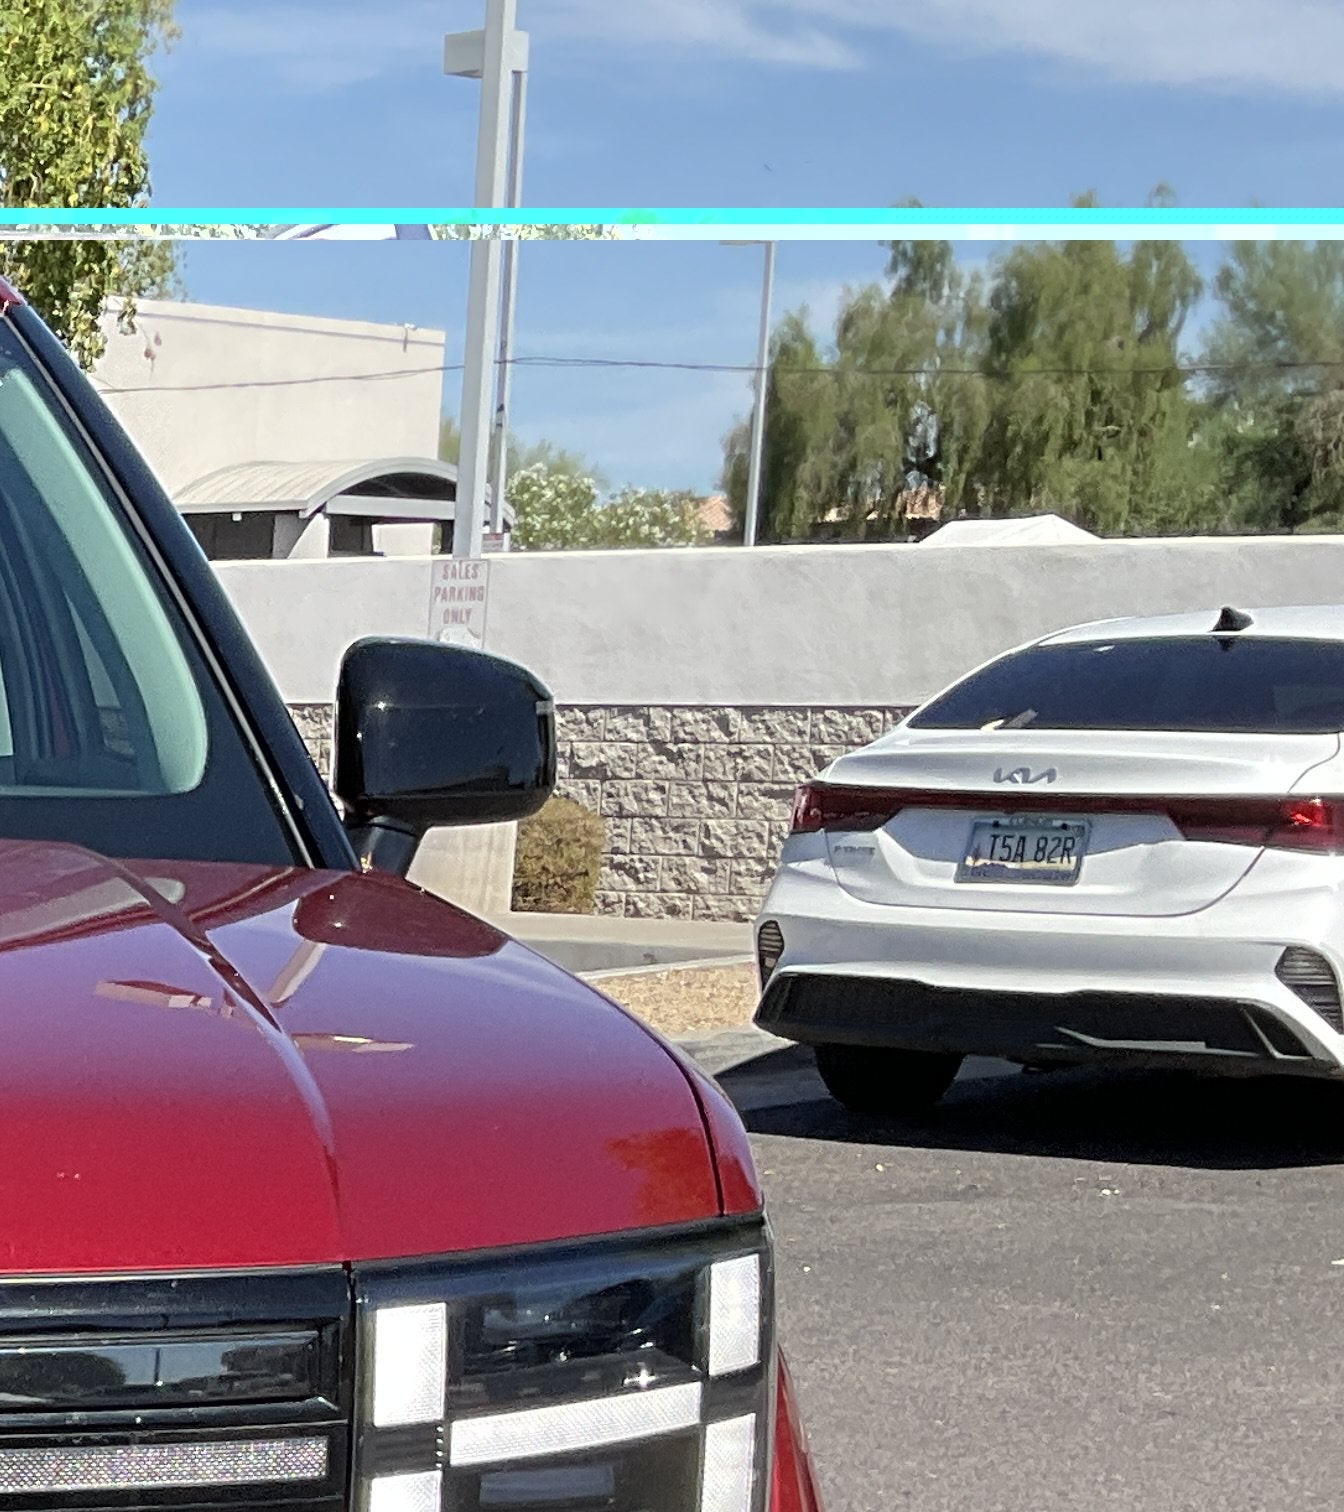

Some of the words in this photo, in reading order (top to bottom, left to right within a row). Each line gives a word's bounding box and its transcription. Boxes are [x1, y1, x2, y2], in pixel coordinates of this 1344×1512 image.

[442, 562, 480, 580] SALES
[434, 586, 485, 602] PARKING
[443, 608, 473, 625] ONLY
